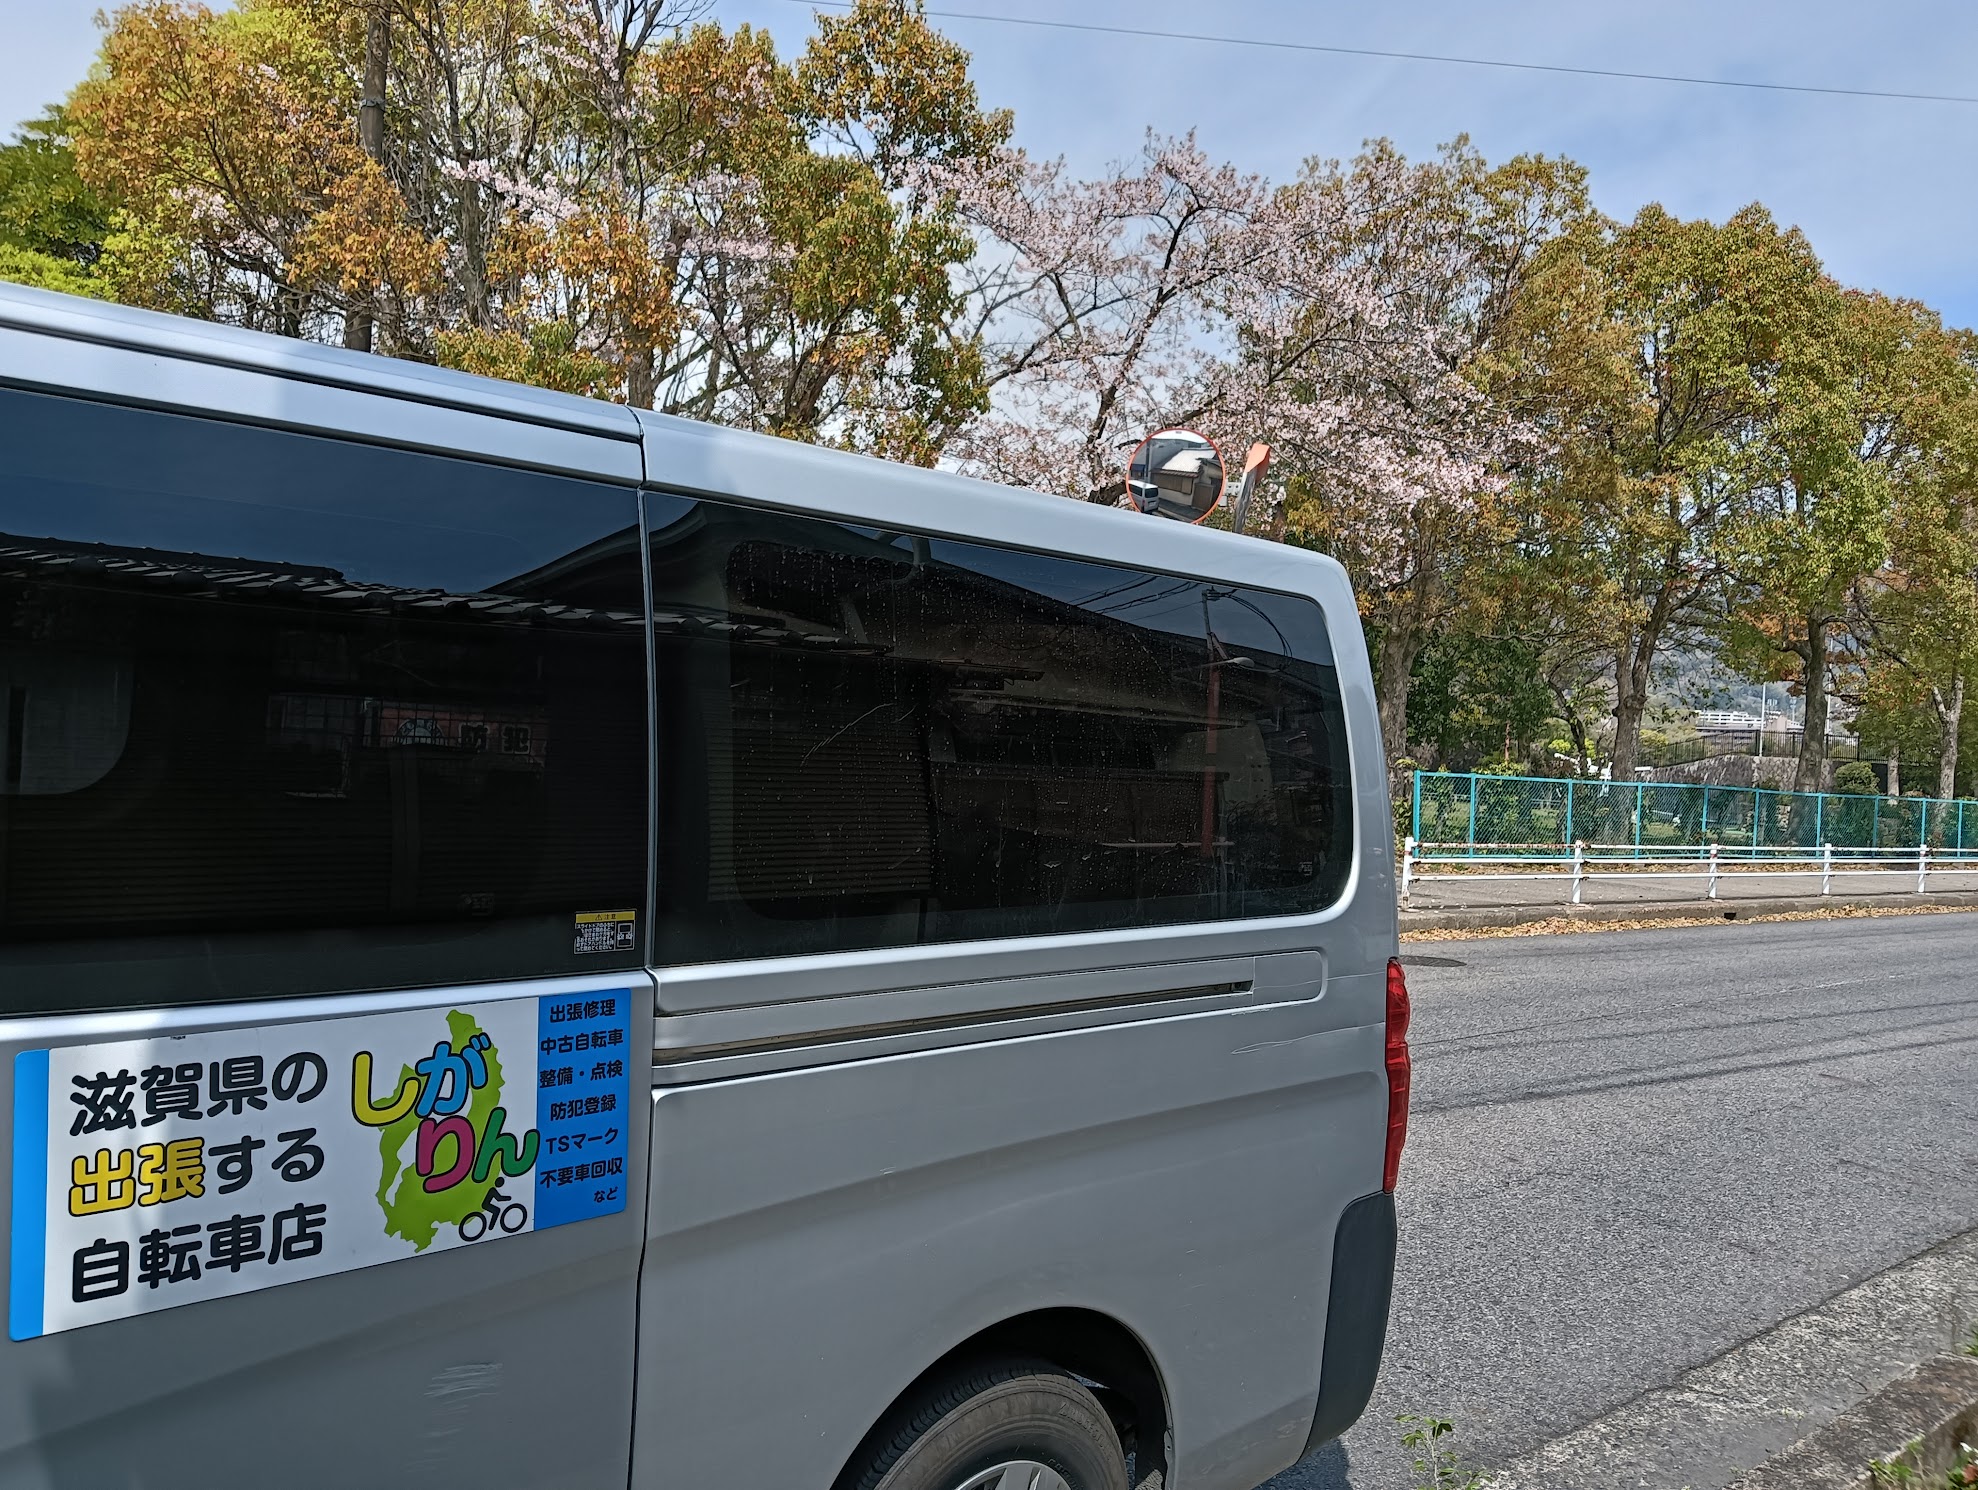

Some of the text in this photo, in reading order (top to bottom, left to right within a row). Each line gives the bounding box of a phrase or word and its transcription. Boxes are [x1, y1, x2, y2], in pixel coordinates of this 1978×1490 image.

[549, 998, 616, 1023] 出張修理
[540, 1028, 624, 1055] 中古自転車
[539, 1060, 623, 1088] 整備・点検
[69, 1051, 328, 1137] 滋賀県の
[549, 1093, 616, 1121] 防犯登録
[545, 1127, 619, 1154] TSマーク
[68, 1127, 326, 1217] 出張する
[540, 1156, 623, 1188] 不要車回収
[593, 1186, 619, 1203] など
[72, 1202, 327, 1303] 自転車店
